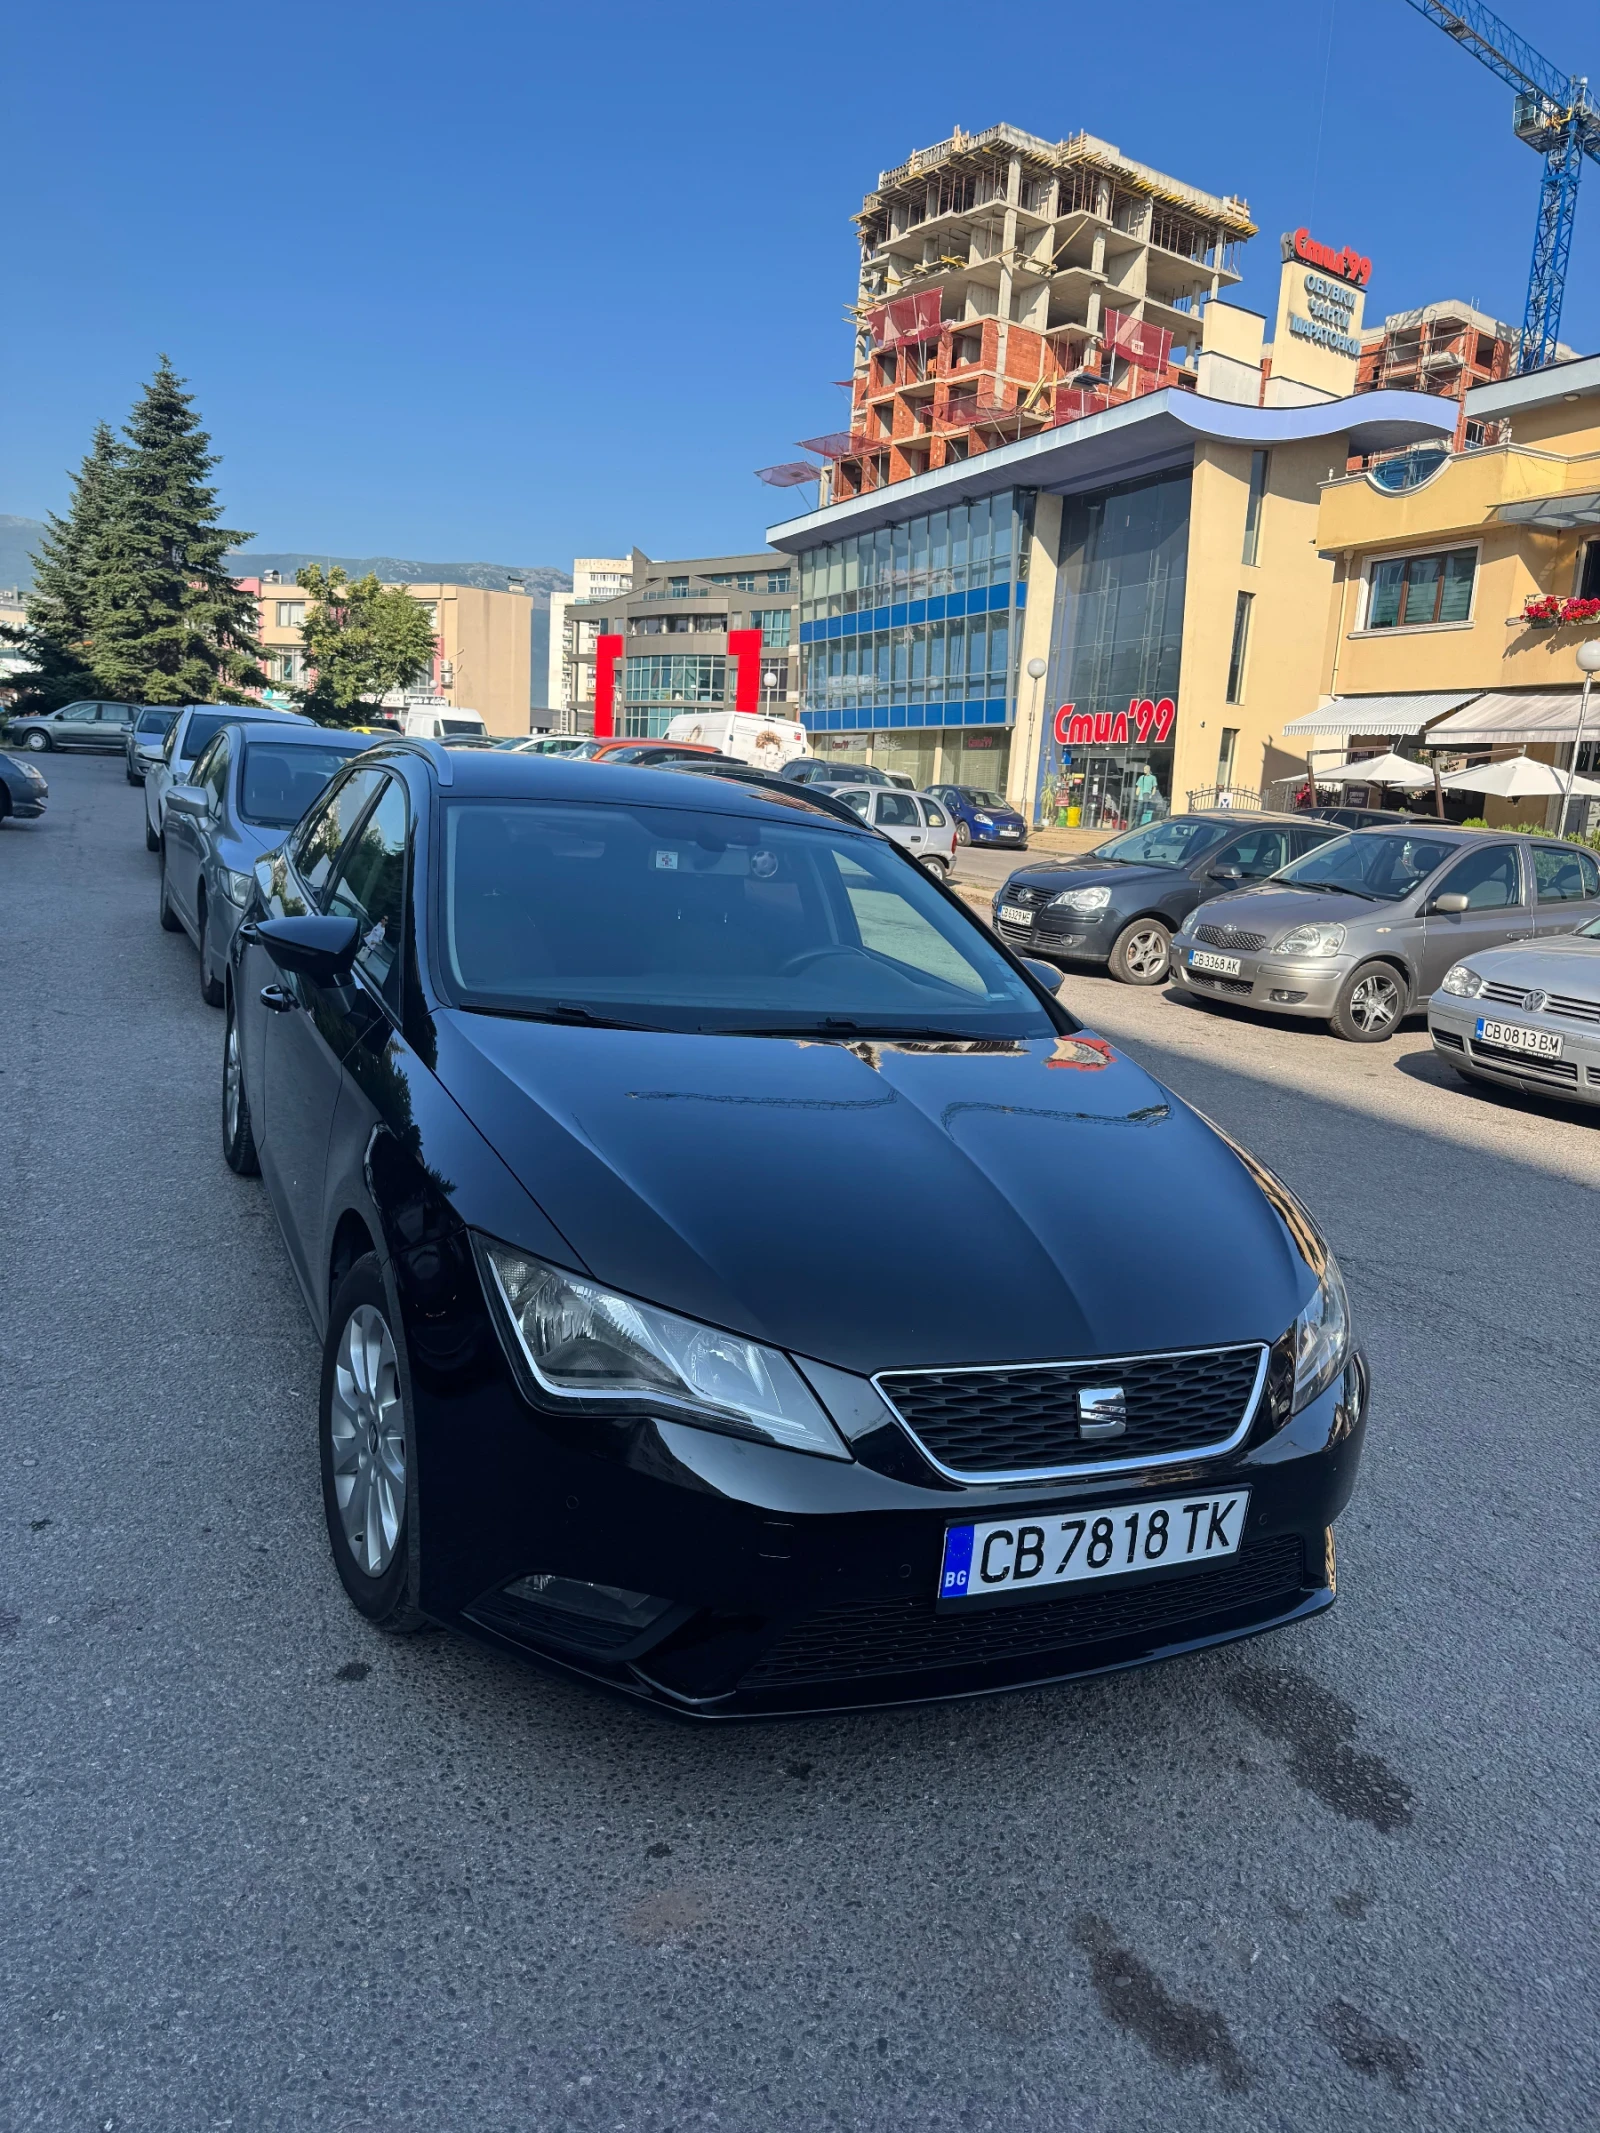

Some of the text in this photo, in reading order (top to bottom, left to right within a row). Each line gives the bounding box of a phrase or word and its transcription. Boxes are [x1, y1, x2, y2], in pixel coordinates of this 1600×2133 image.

[1294, 227, 1372, 286] Стил'99
[1304, 273, 1357, 309] ОБУВКИ
[1309, 298, 1351, 329] ЧАНТИ
[1290, 314, 1361, 356] МАРАТОНКИ
[1053, 697, 1176, 745] Стил'99
[1194, 953, 1238, 973] CB 3368 AK
[1484, 1022, 1560, 1053] CB 0813 BM
[980, 1498, 1238, 1584] CB 7818 TK
[945, 1570, 967, 1588] BG
